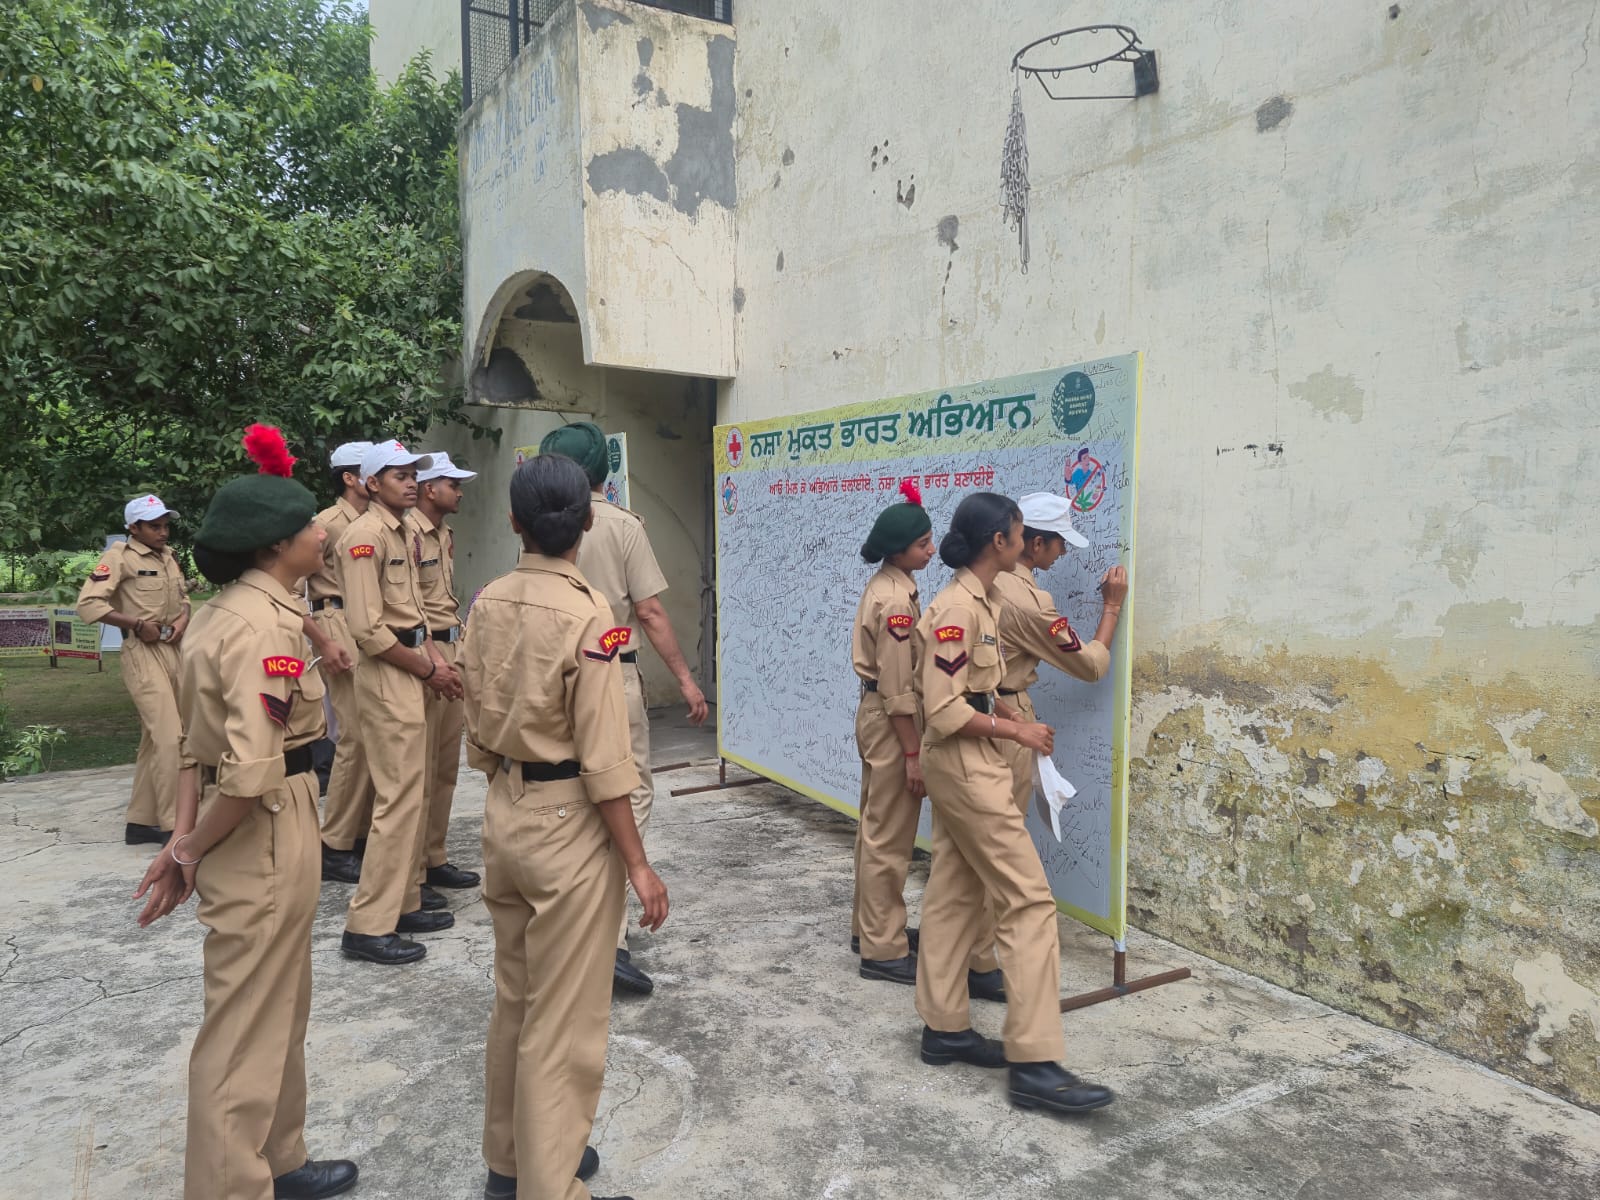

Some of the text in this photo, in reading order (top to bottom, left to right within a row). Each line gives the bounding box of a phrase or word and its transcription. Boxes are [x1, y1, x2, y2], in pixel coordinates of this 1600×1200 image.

[750, 393, 1036, 460] ਨਸ਼ਾ ਮੁਕਤ ਭਾਰਤ ਅਭਿਆਨ
[809, 477, 838, 494] ਅਭਿਆਨ
[924, 473, 950, 488] ਭਾਰਤ
[353, 546, 371, 556] NCC
[890, 617, 910, 625] NCC
[1051, 620, 1066, 636] NCC
[604, 631, 627, 648] NCC
[938, 628, 961, 640] NCC
[267, 659, 299, 673] NCC
